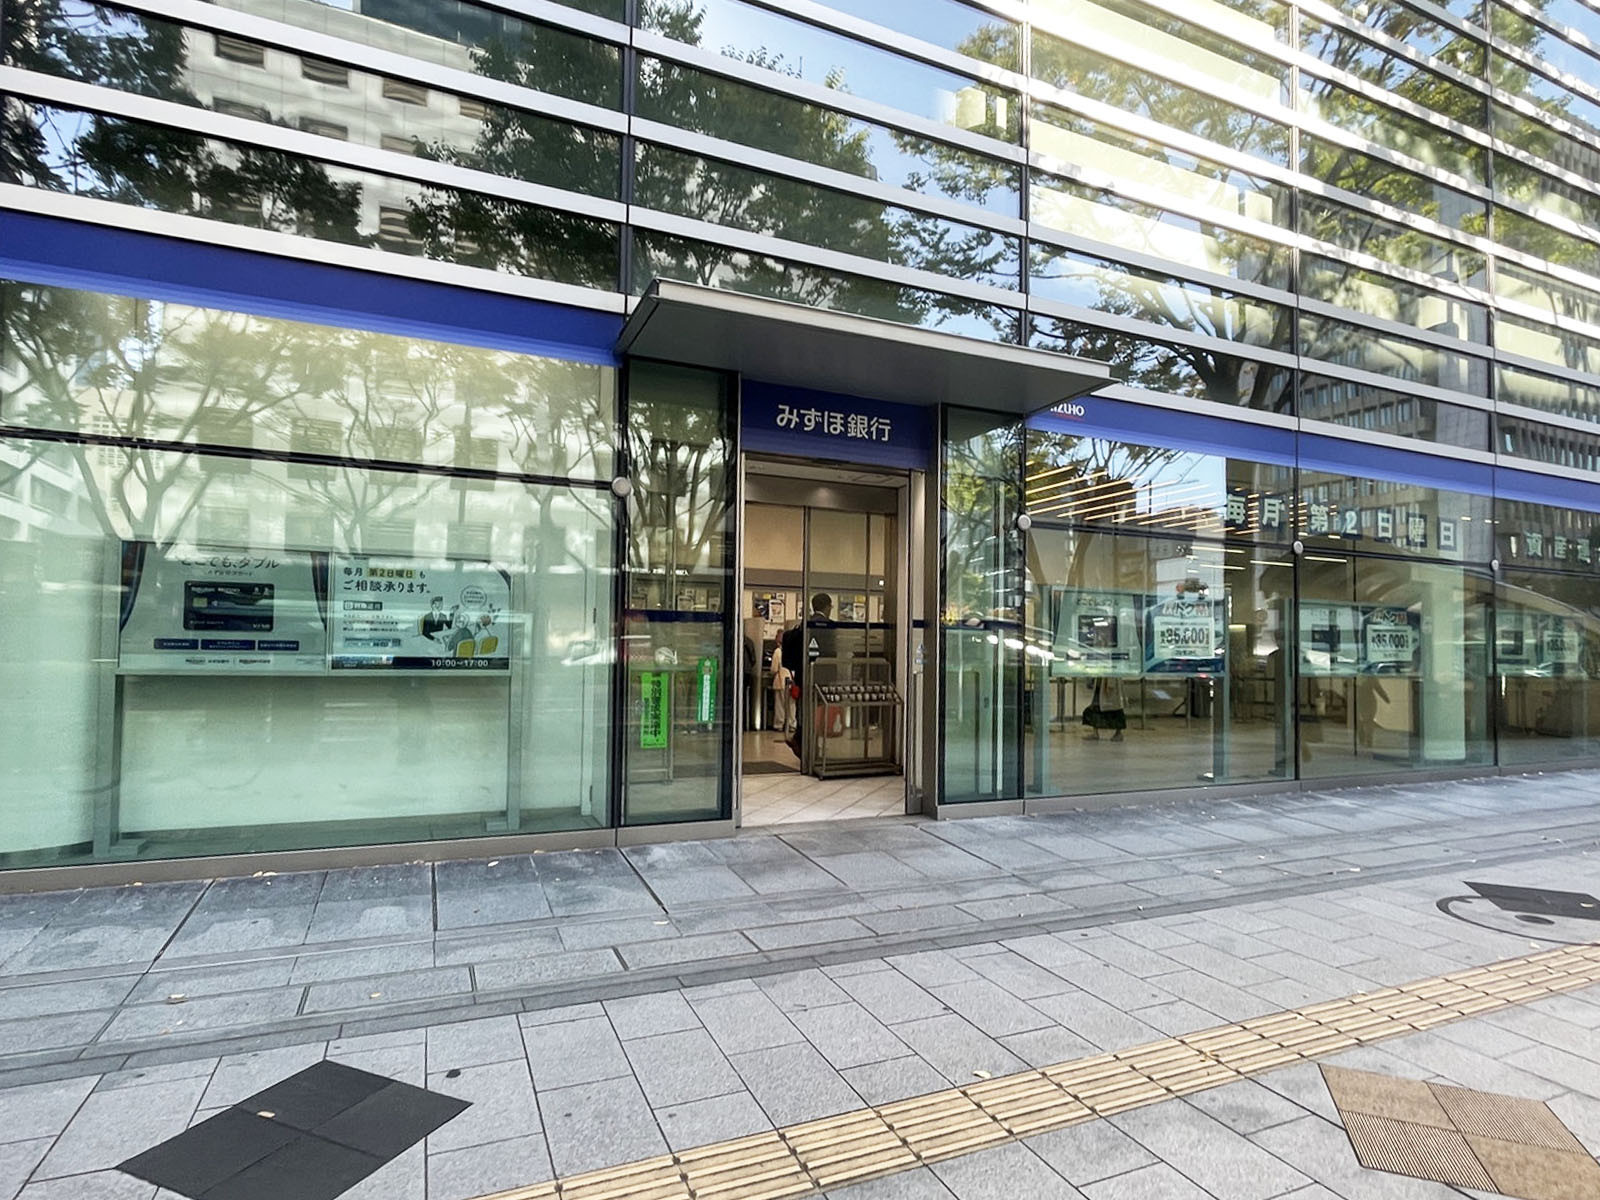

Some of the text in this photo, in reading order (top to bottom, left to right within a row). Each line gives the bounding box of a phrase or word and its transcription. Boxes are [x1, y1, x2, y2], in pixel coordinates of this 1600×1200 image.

[1050, 403, 1085, 417] IZUHO
[776, 404, 892, 442] みずほ銀行
[1524, 530, 1600, 564] 資産運
[343, 567, 363, 577] 毎月
[368, 568, 413, 578] 第2日曜日
[343, 579, 431, 594] ご相談承ります。
